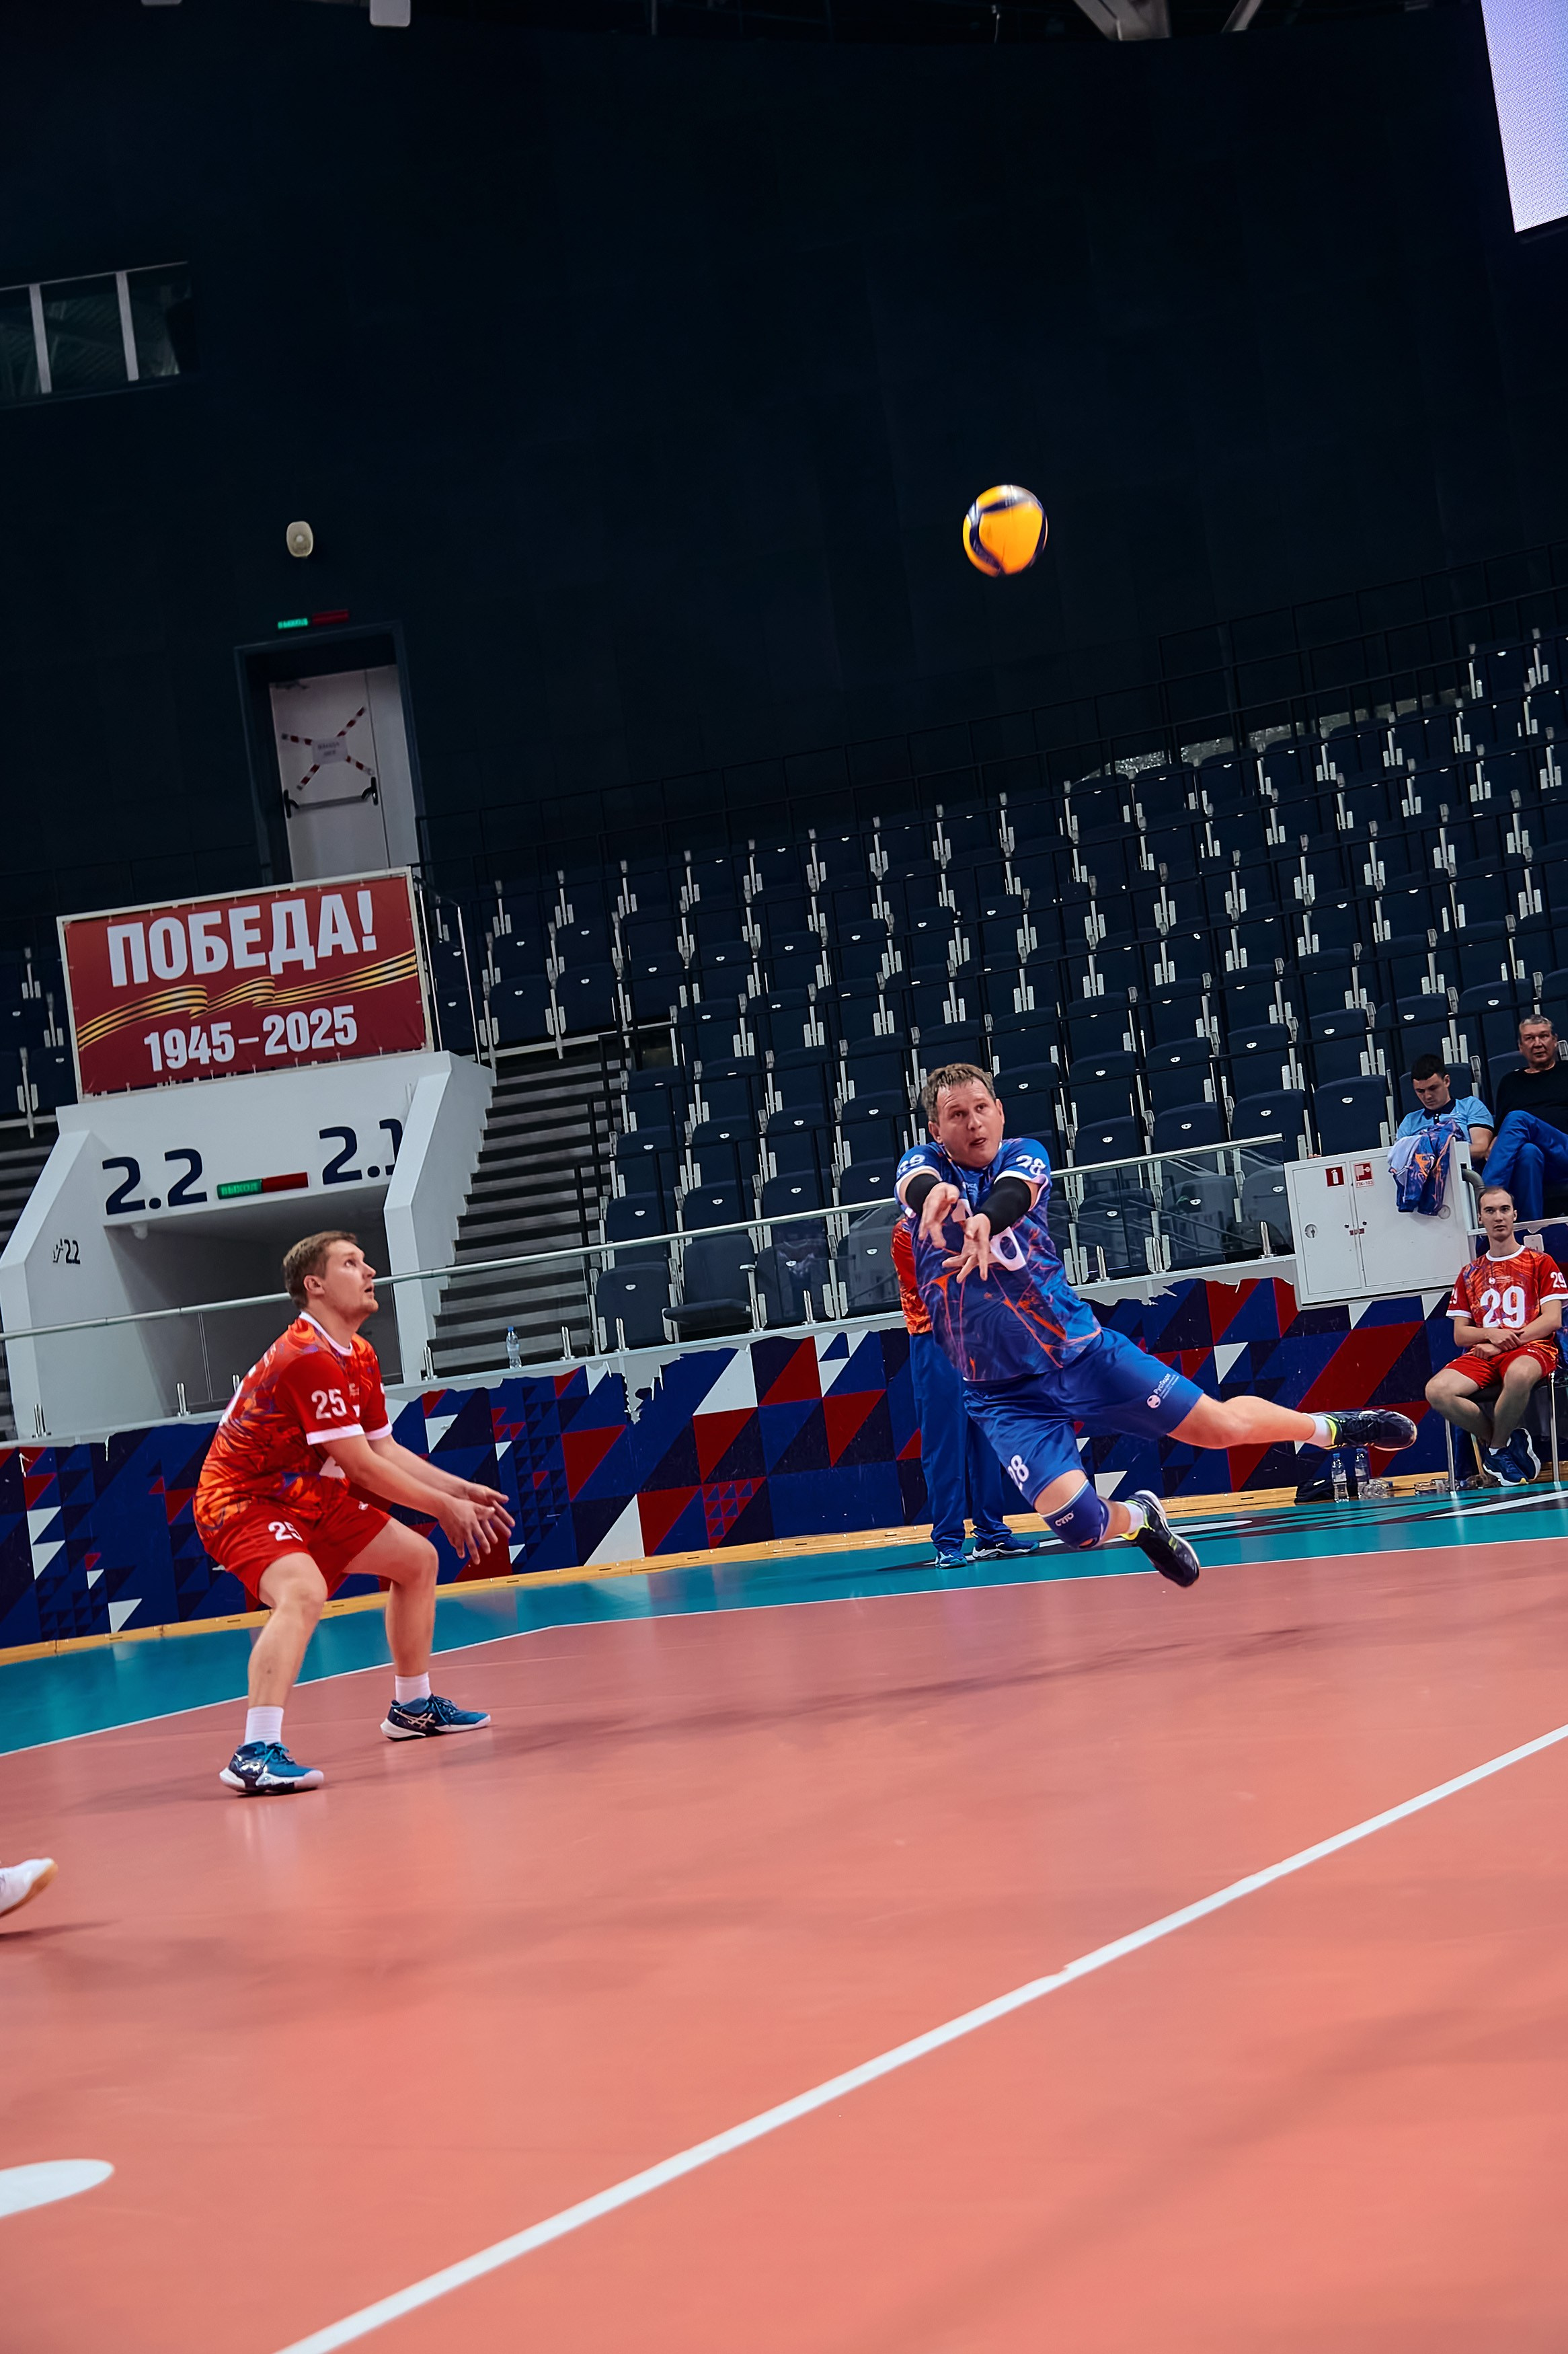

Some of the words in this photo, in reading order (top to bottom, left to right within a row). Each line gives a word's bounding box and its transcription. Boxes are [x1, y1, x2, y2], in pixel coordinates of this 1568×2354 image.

[107, 890, 377, 987] ПОБЕДА!
[1015, 1154, 1046, 1176] 28
[102, 1148, 208, 1215] 2.2
[1550, 1271, 1567, 1289] 29
[1480, 1285, 1525, 1328] 29
[311, 1388, 347, 1420] 25
[268, 1521, 303, 1542] 25
